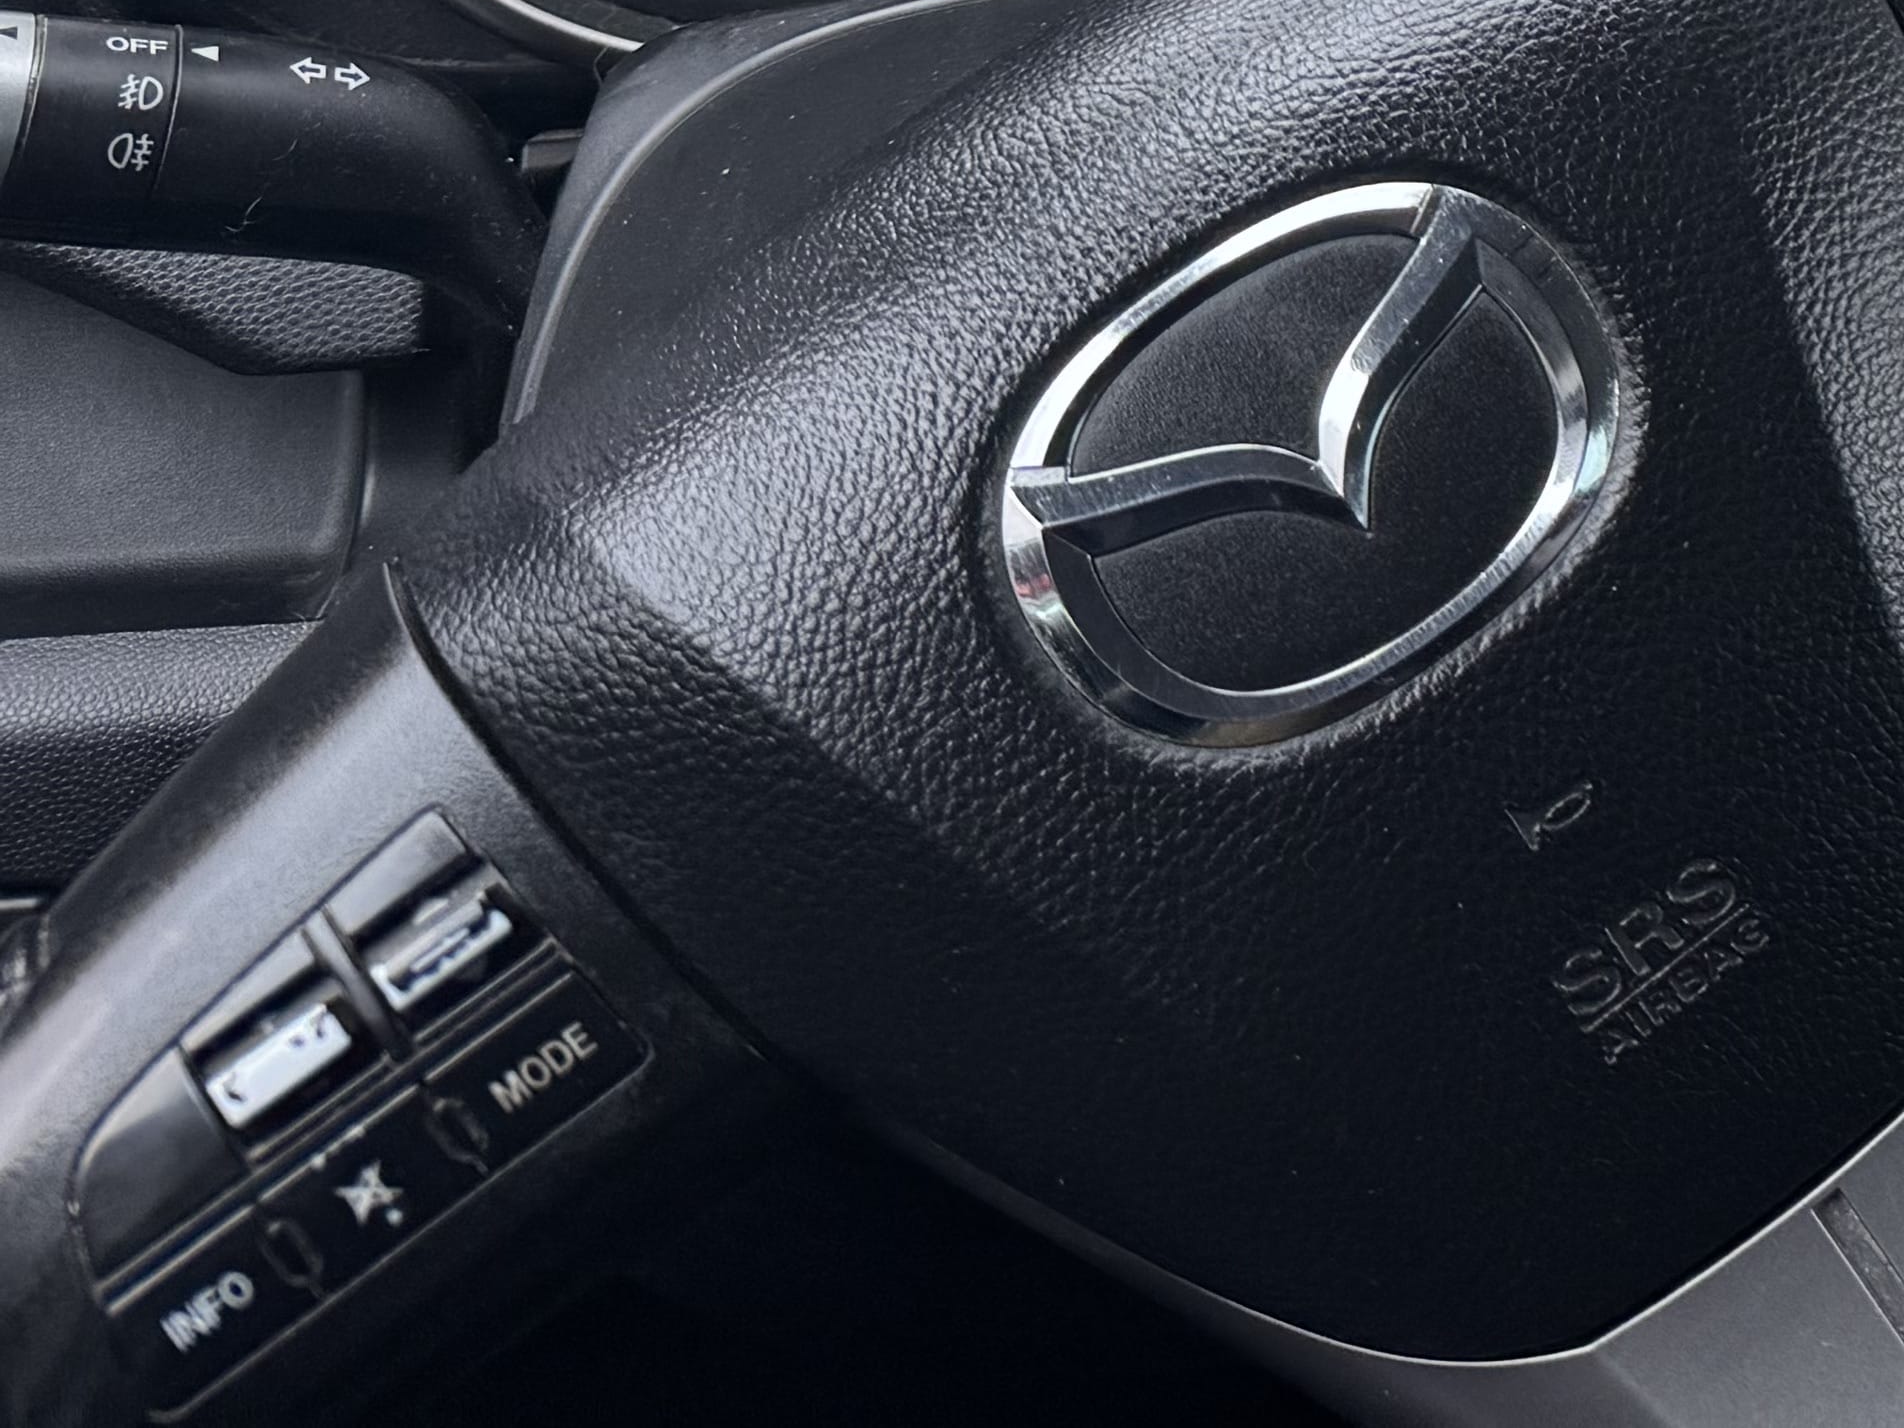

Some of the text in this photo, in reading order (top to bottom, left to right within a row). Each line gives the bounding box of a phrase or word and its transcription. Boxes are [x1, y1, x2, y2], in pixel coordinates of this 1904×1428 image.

[105, 36, 168, 56] OFF
[1553, 858, 1738, 1016] SRS
[488, 1022, 598, 1114] MODE
[160, 1270, 255, 1353] INFO
